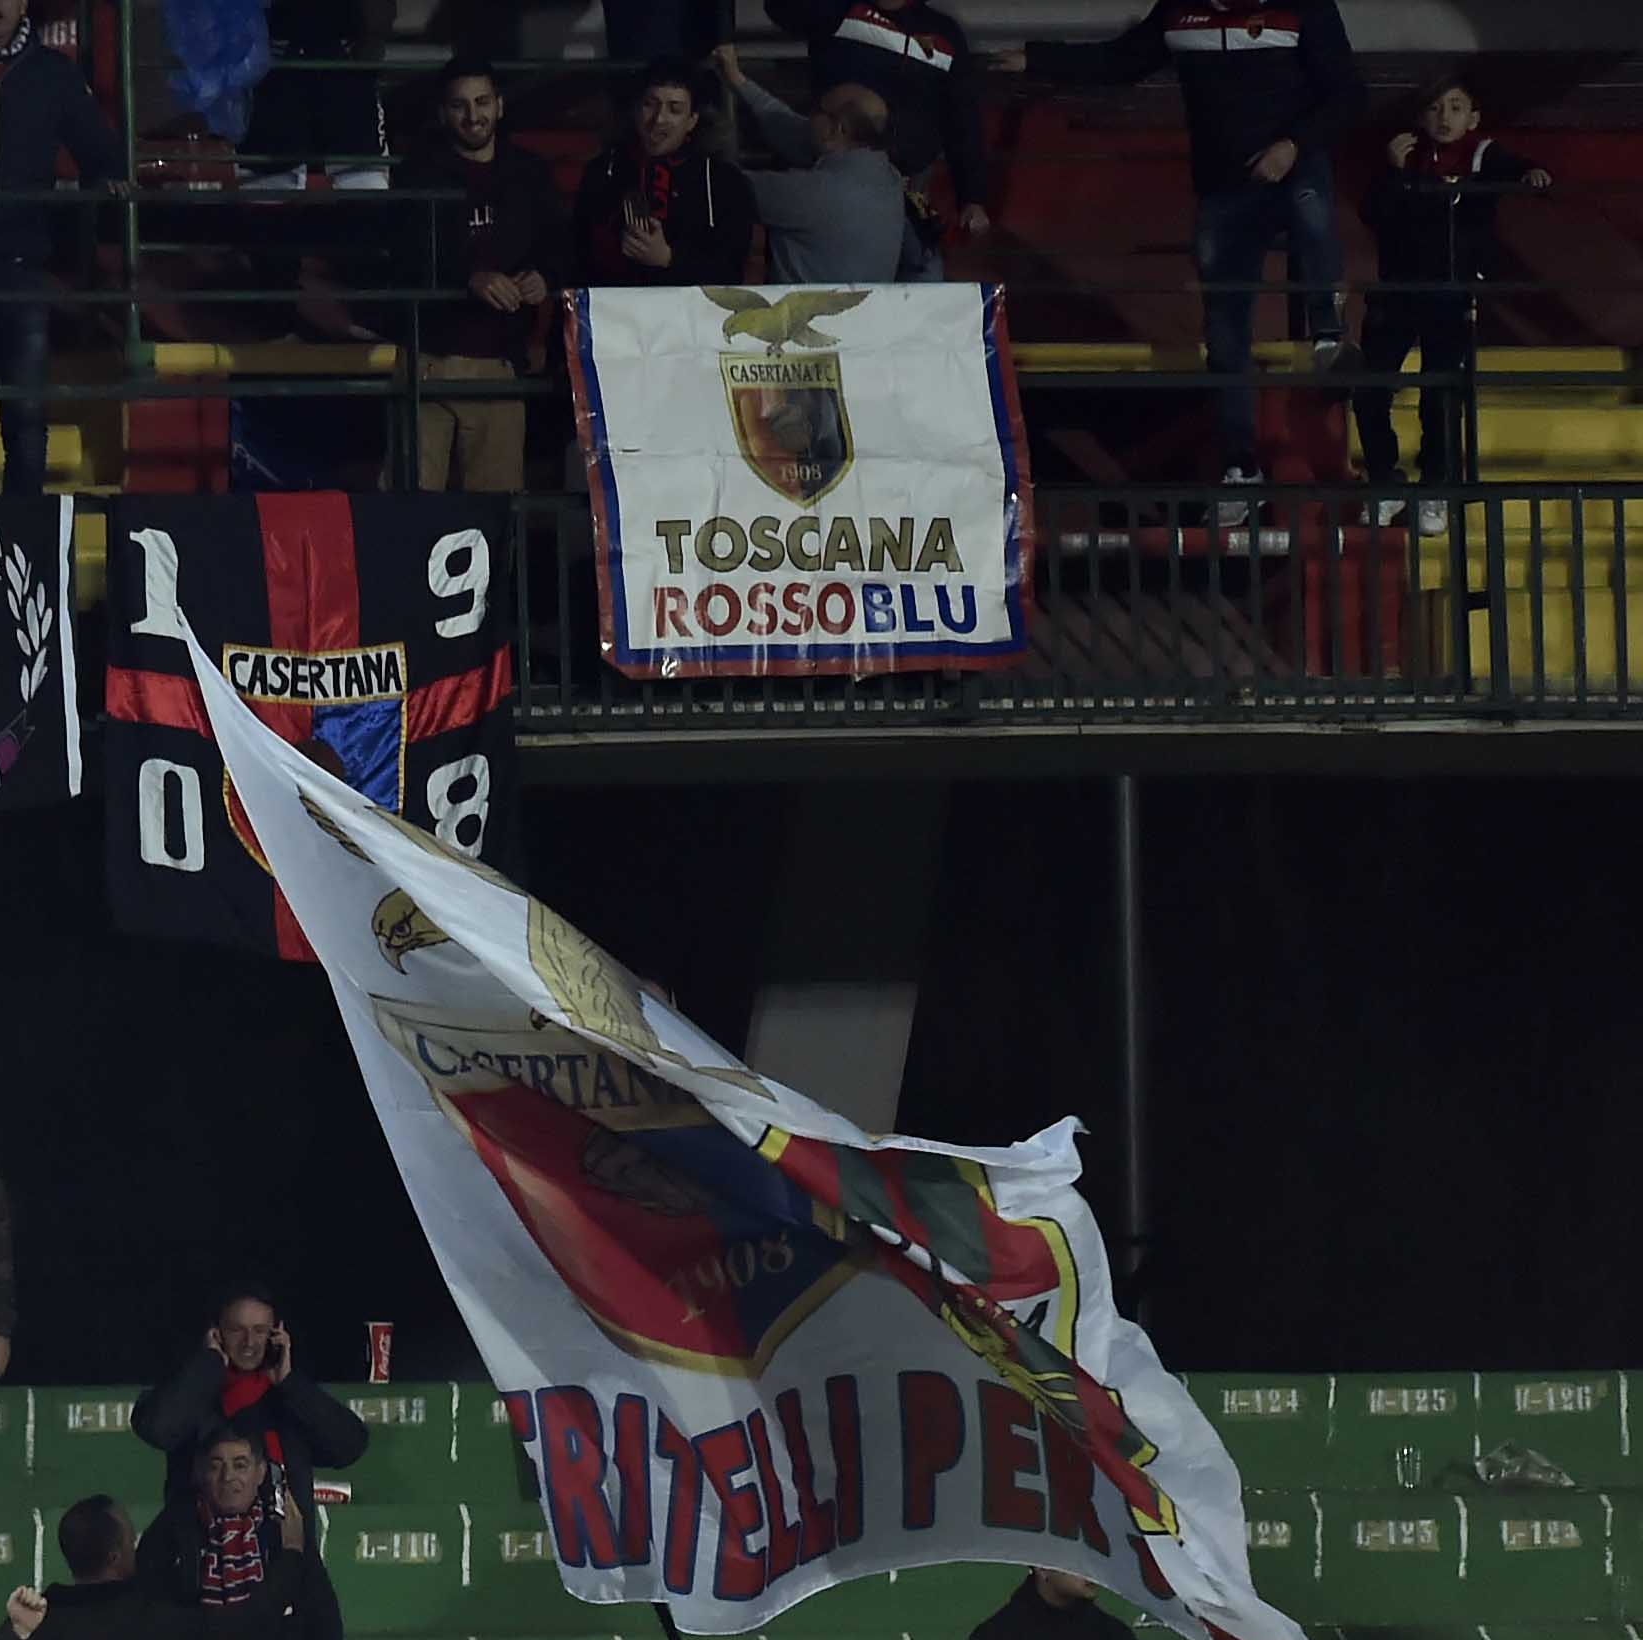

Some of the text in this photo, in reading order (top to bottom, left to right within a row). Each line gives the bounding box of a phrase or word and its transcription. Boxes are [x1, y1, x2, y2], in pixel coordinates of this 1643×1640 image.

[730, 362, 813, 383] CASERTANA
[656, 516, 964, 574] TOSCANA
[653, 581, 977, 639] ROSSOBLU
[229, 651, 403, 699] CASERTANA
